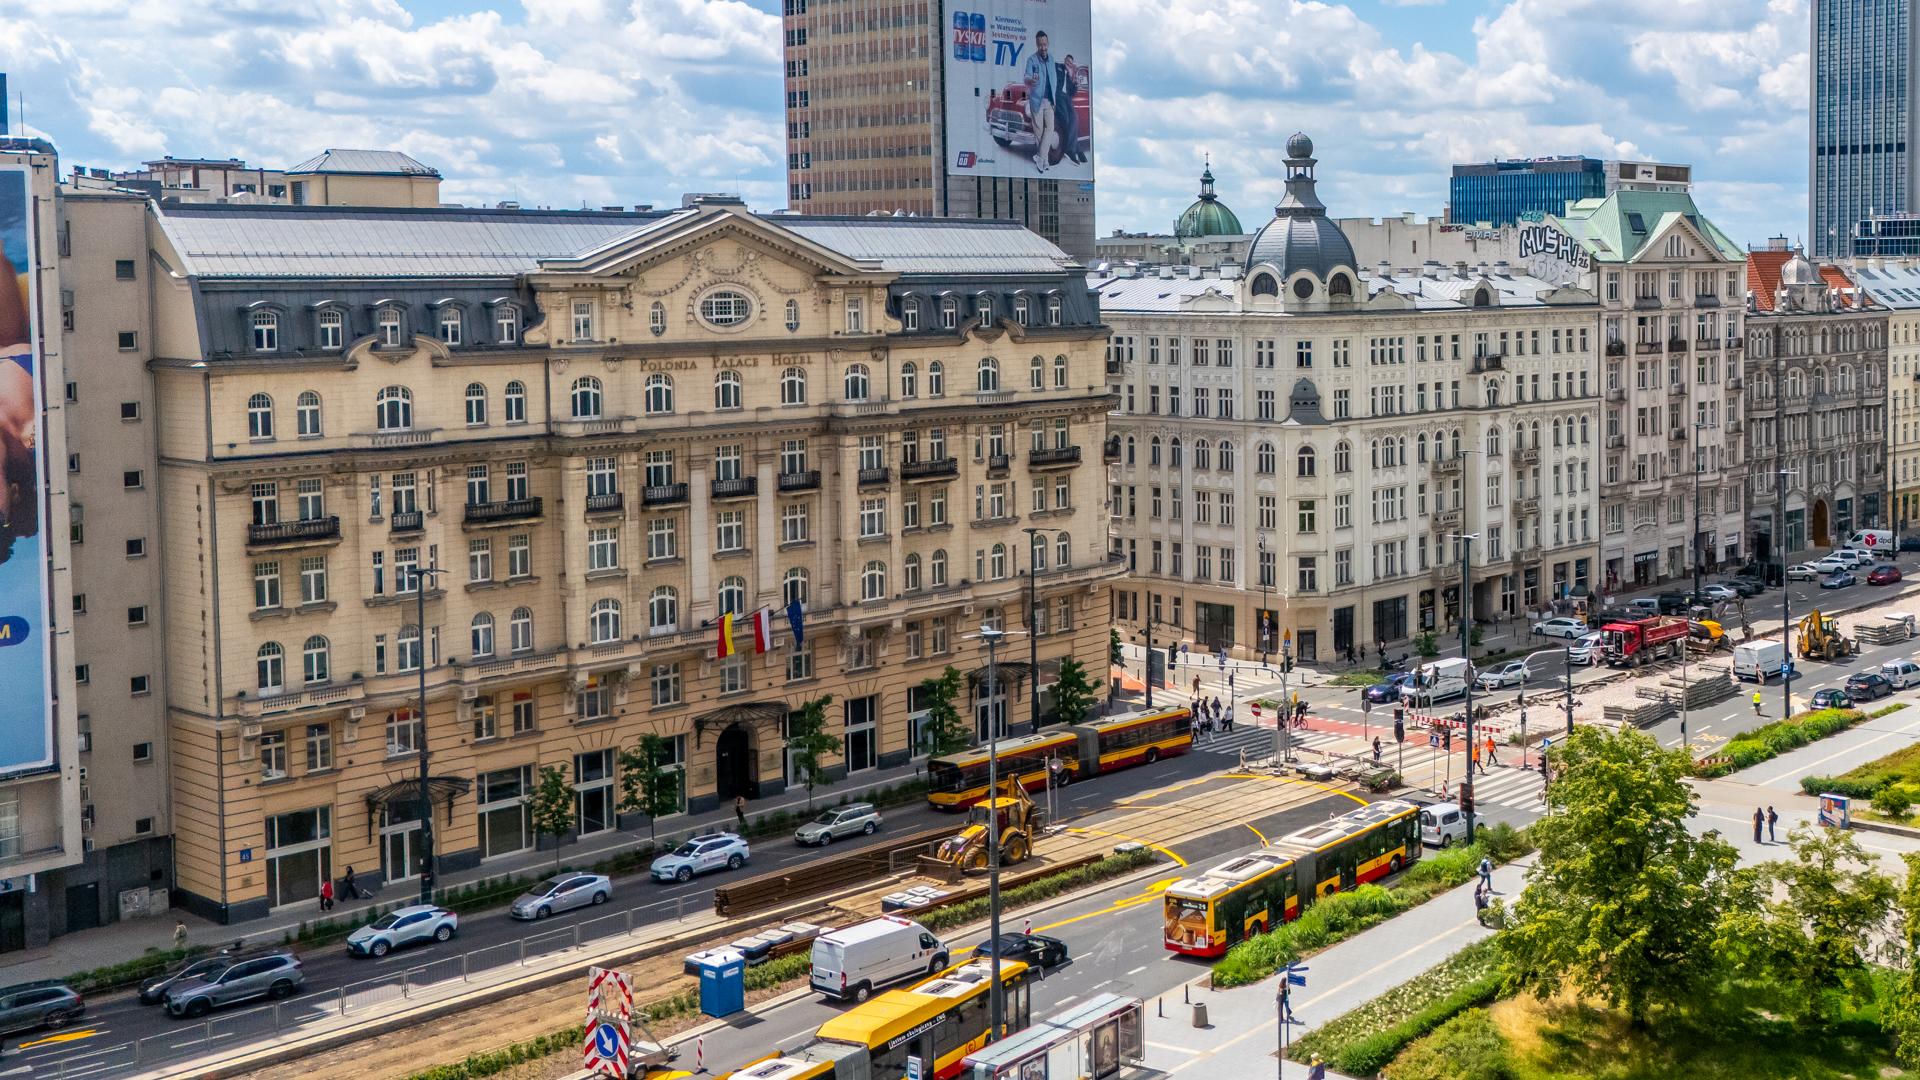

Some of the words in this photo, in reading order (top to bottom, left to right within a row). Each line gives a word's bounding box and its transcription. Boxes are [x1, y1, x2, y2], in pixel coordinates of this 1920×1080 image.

[992, 40, 1024, 66] TY
[640, 358, 697, 372] POLONIA
[712, 355, 759, 369] PALACE
[771, 352, 813, 366] HOTEL
